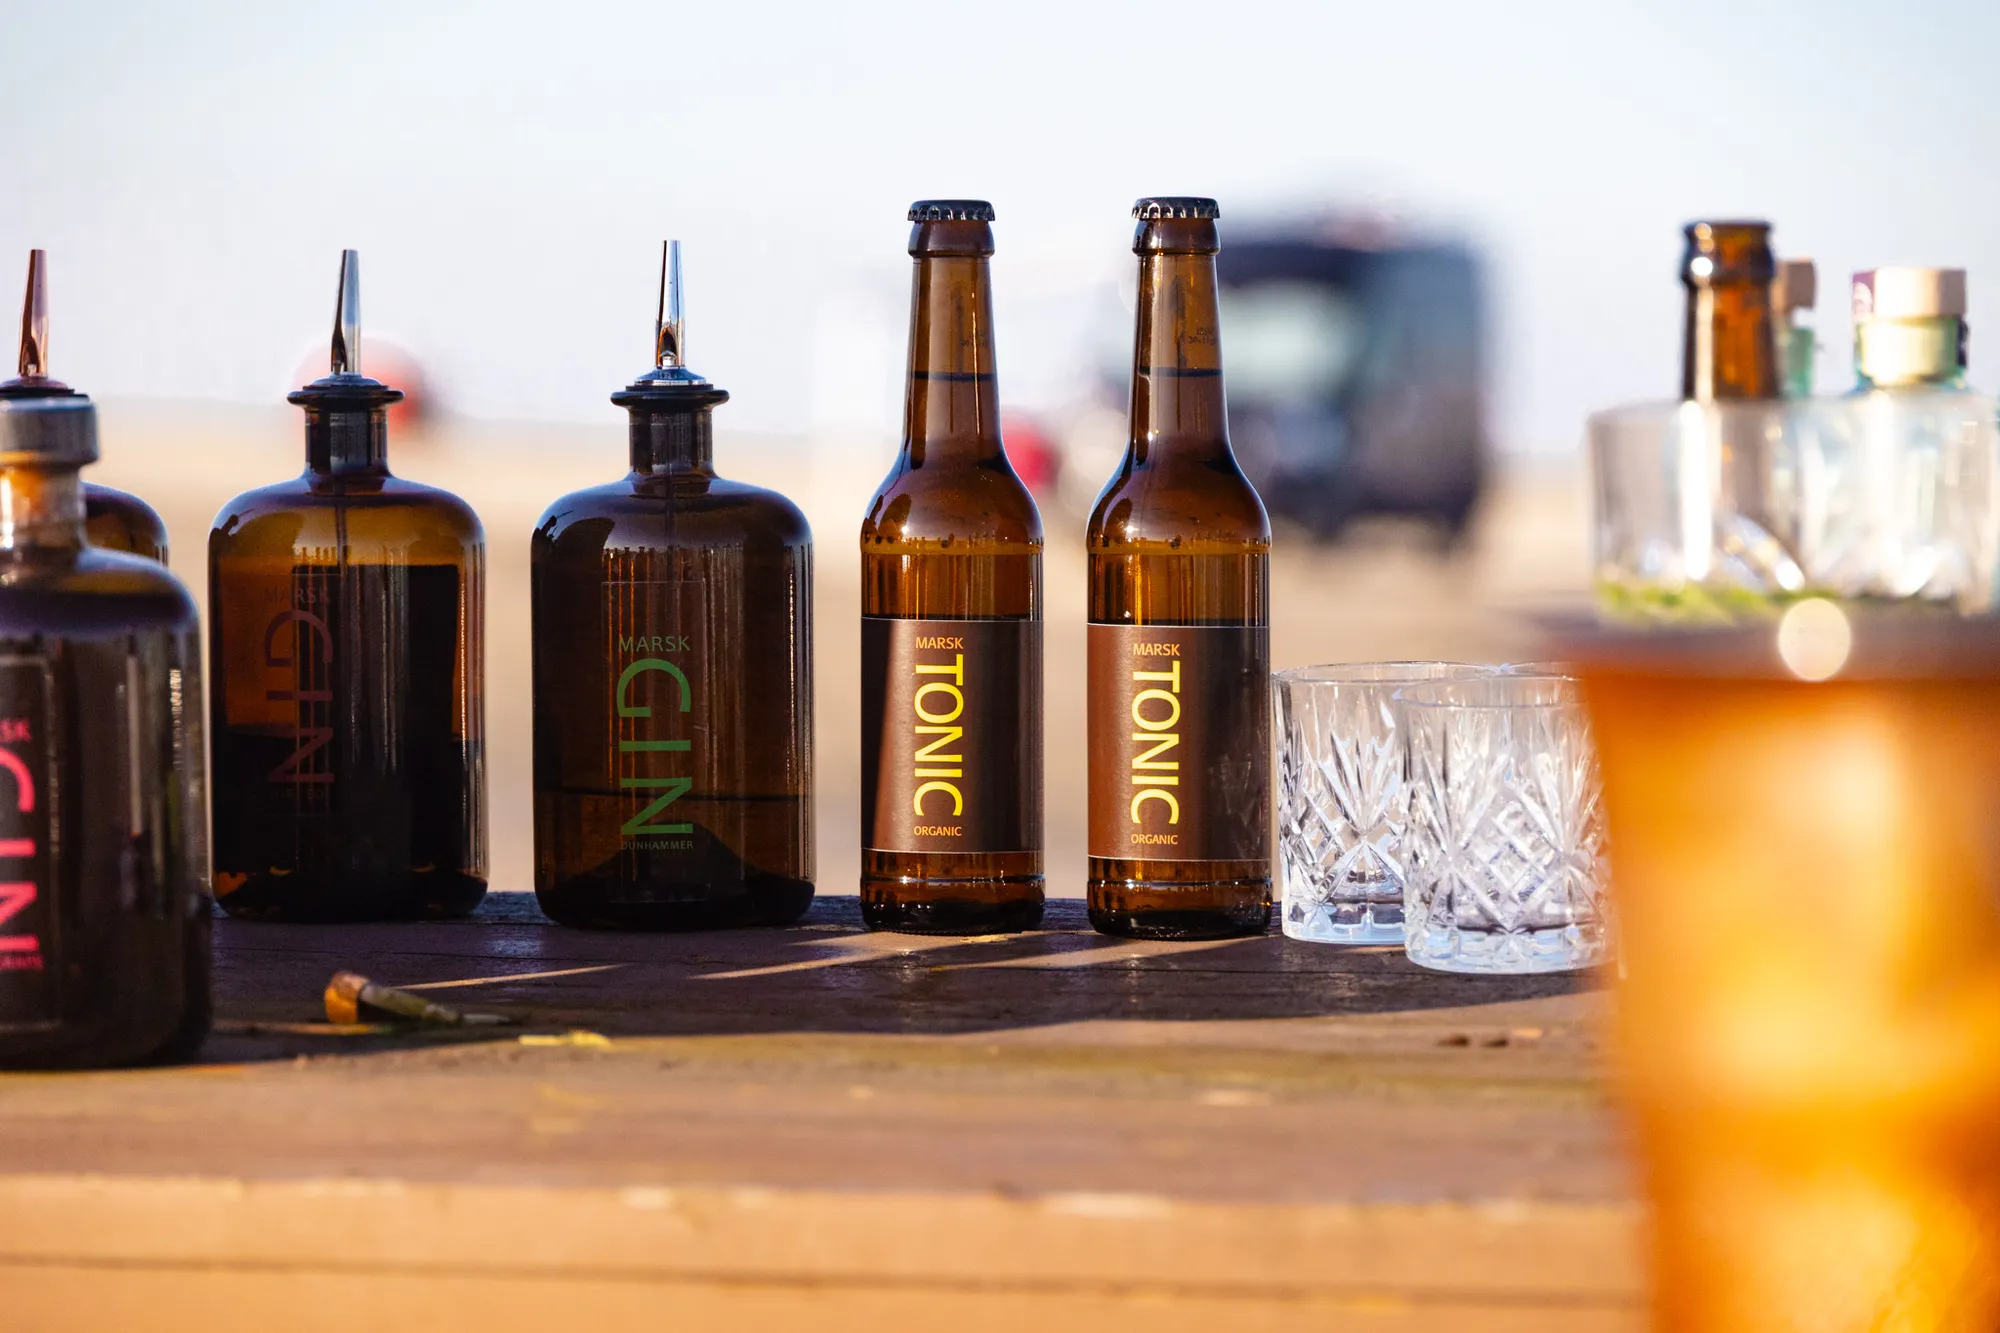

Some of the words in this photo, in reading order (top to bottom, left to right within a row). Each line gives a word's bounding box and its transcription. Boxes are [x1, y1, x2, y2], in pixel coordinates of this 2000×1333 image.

[264, 587, 331, 604] MARSK
[618, 635, 691, 652] MARSK
[915, 636, 964, 650] MARSK
[1132, 642, 1181, 657] MARSK
[265, 609, 335, 783] GIN
[913, 653, 964, 817] TONIC
[1130, 660, 1181, 825] TONIC
[616, 657, 694, 835] GIN
[913, 825, 962, 837] ORGANIC
[1130, 833, 1178, 846] ORGANIC
[621, 840, 694, 851] DUNHAMMER
